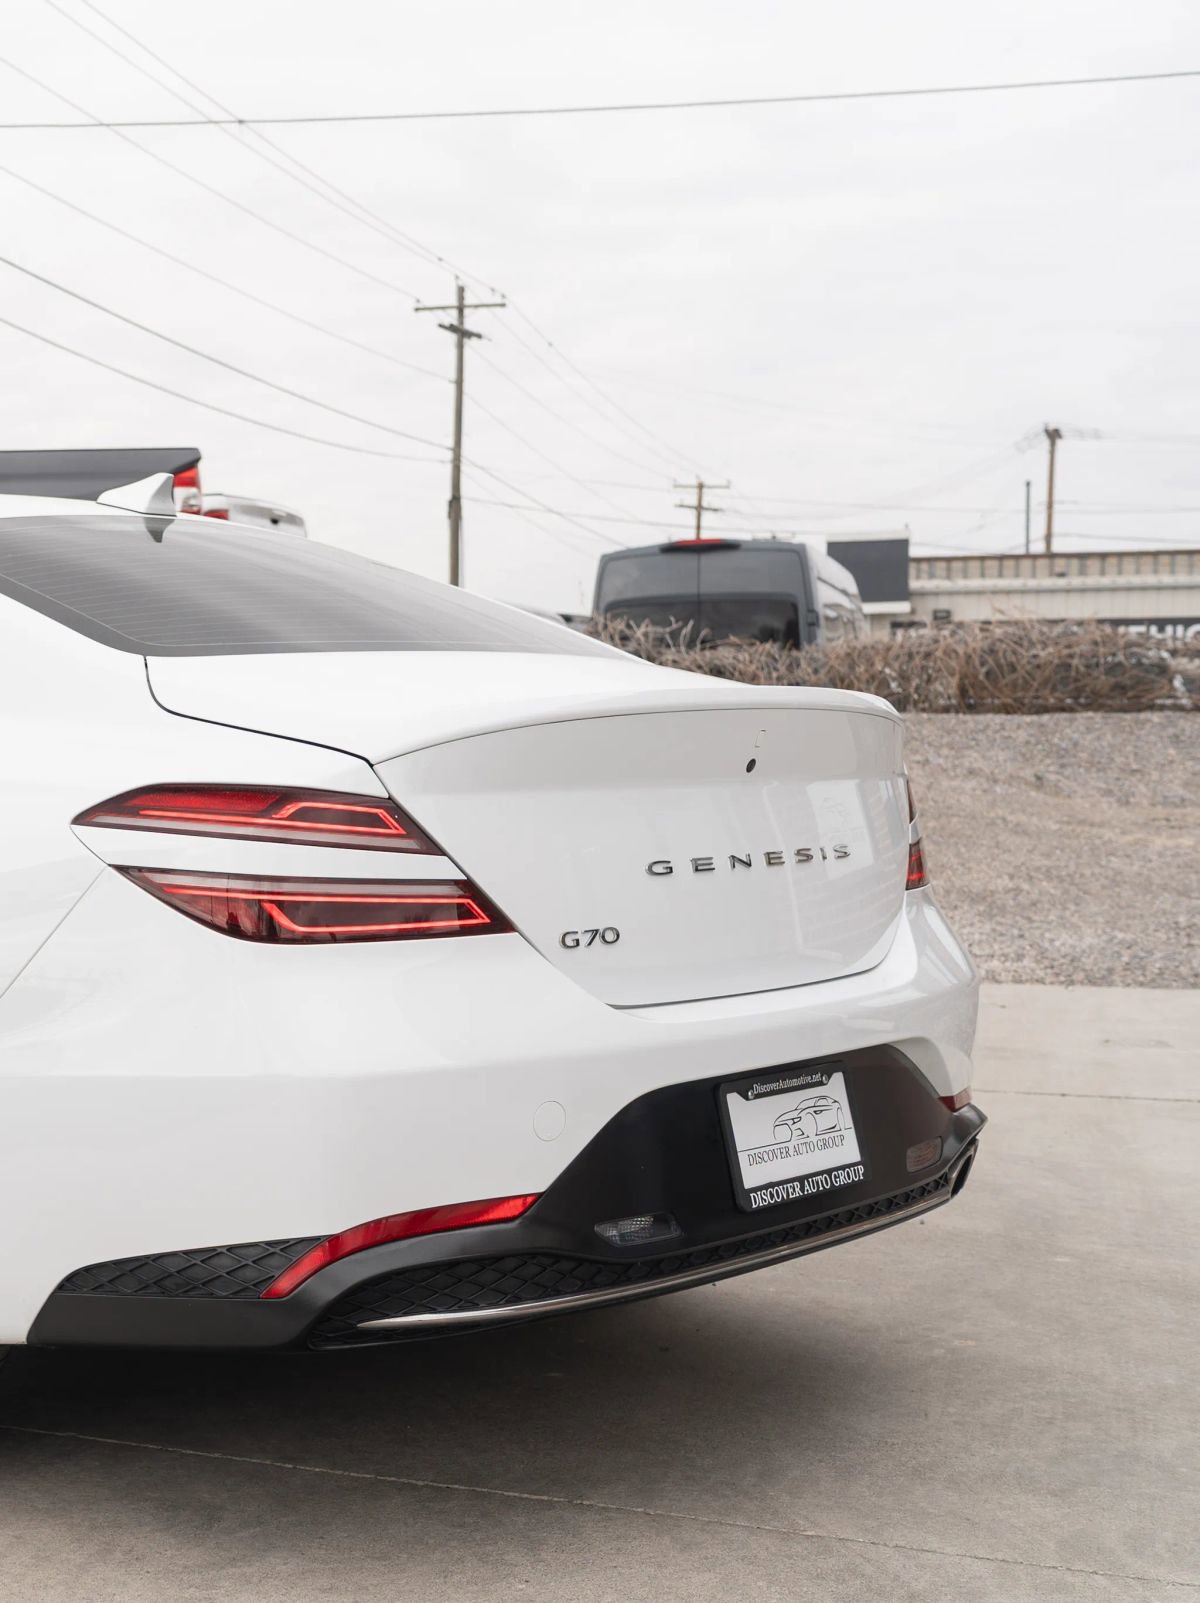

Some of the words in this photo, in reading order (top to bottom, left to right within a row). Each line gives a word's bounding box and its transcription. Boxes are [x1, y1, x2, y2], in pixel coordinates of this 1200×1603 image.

[645, 843, 851, 877] GENESIS
[559, 926, 621, 949] G70
[753, 1072, 821, 1095] DiscoverAutomotive.net
[748, 1146, 792, 1166] DISCOVER
[793, 1140, 815, 1157] AUTO
[816, 1134, 845, 1151] GROUP
[750, 1183, 803, 1208] DISCOVER
[804, 1174, 830, 1194] AUTO
[831, 1165, 865, 1187] GROUP
